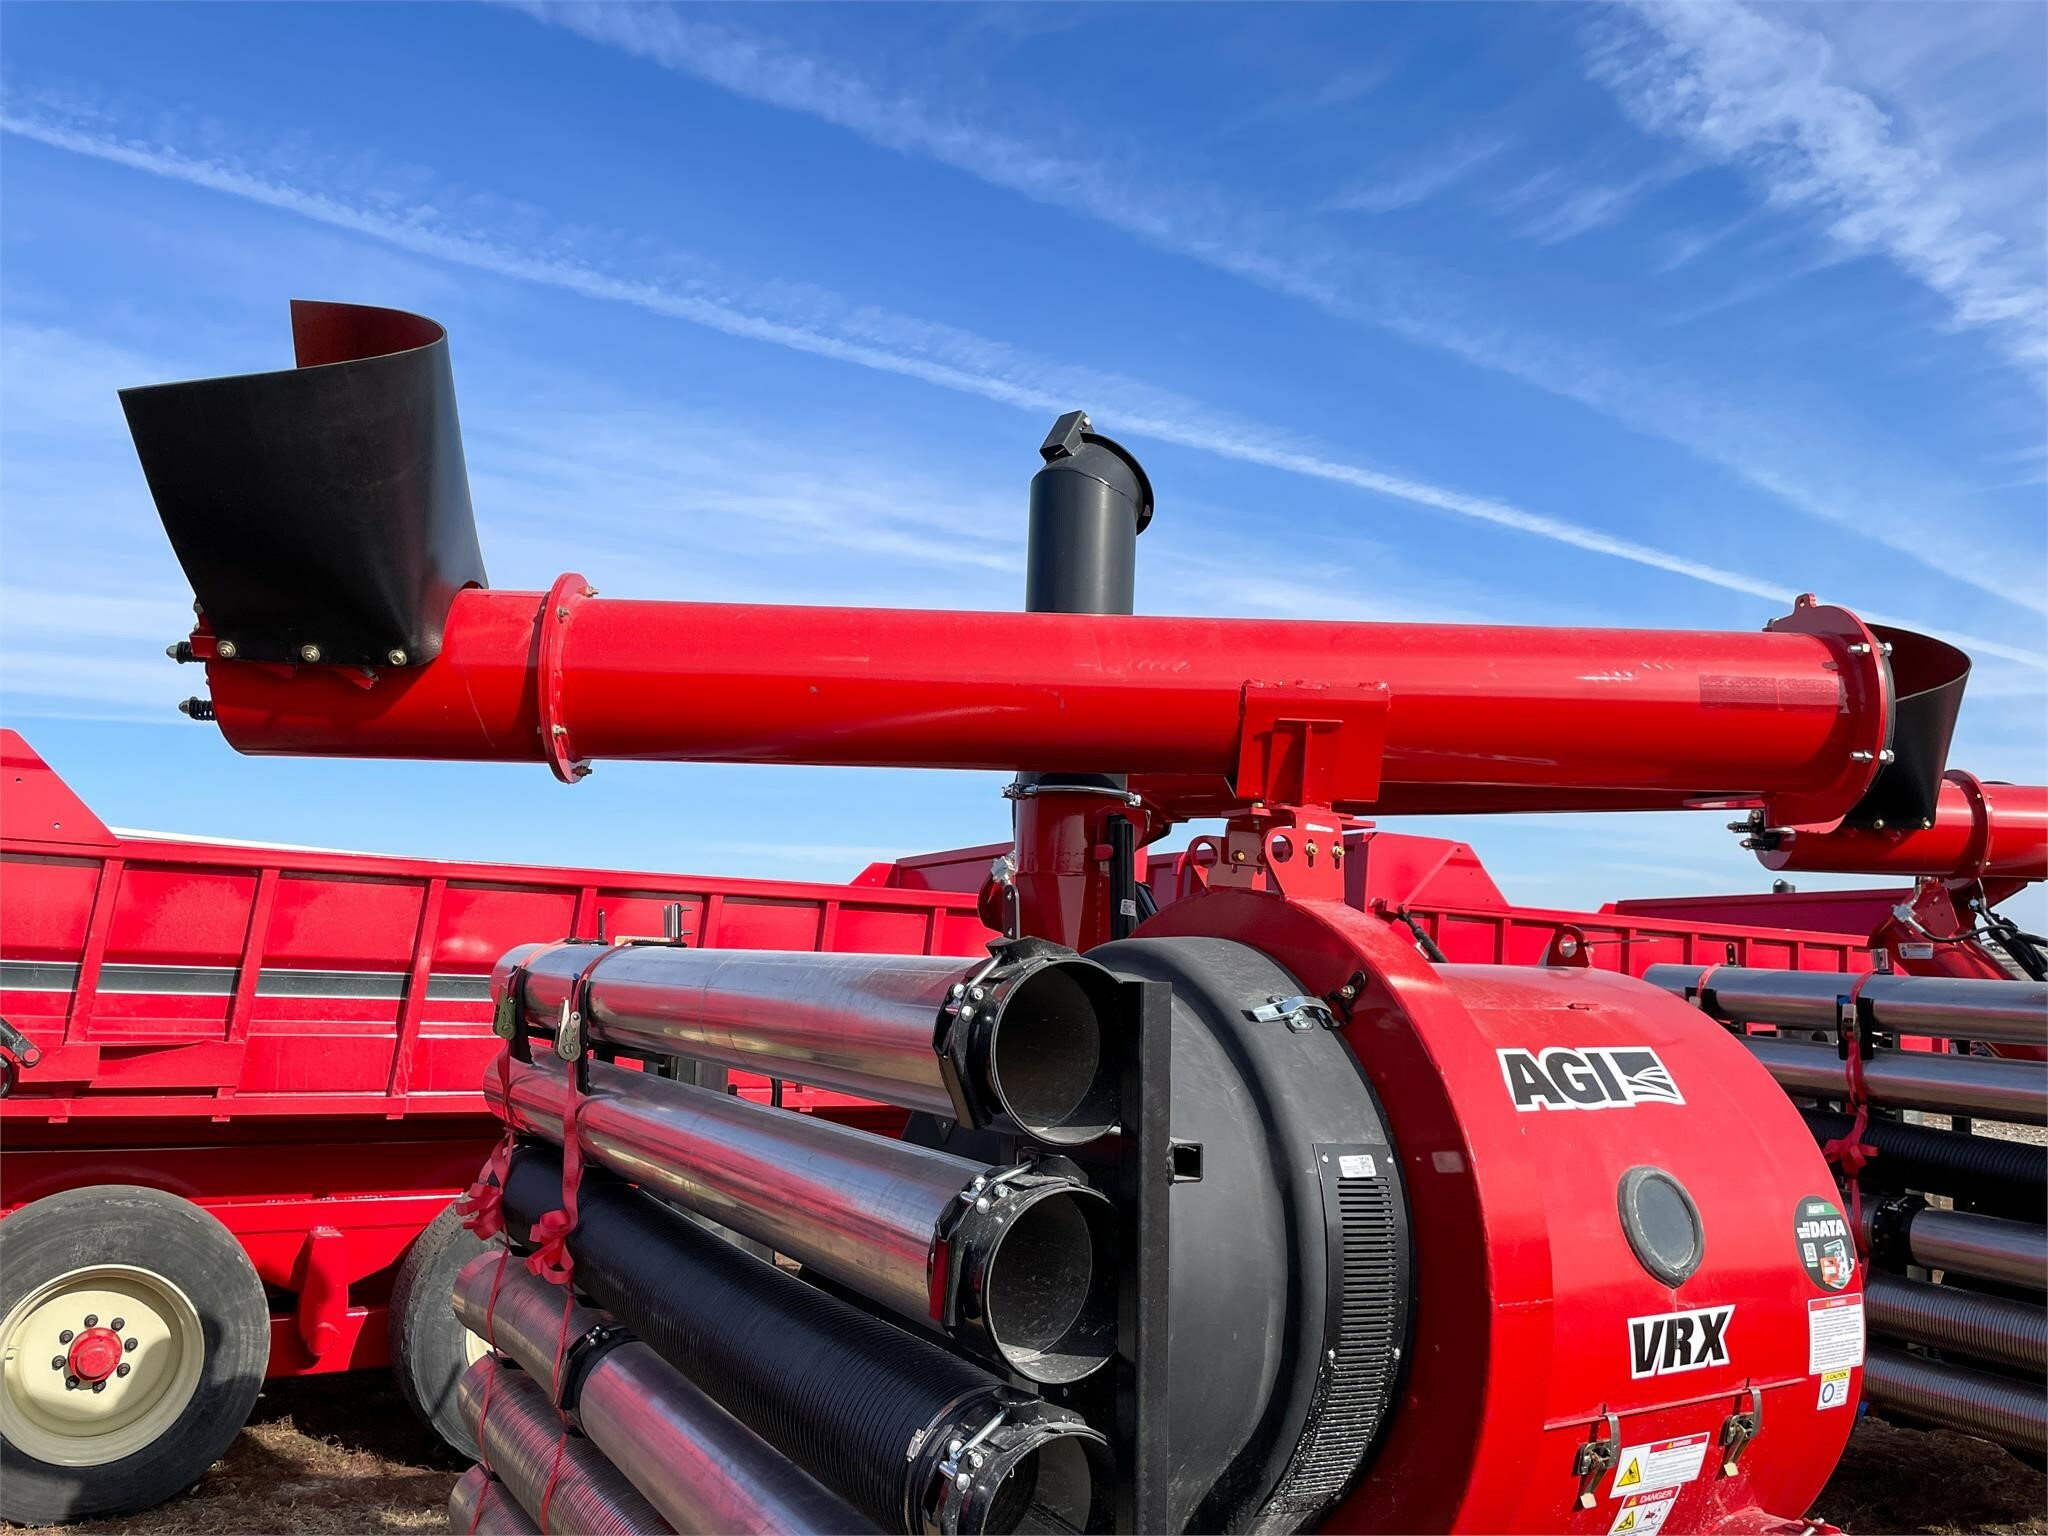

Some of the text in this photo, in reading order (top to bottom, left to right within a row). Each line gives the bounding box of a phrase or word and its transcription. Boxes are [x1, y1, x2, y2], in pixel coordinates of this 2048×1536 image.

[1504, 1052, 1628, 1105] AGI
[1810, 1220, 1847, 1238] DATA
[1632, 1311, 1729, 1373] VRX
[1640, 1490, 1673, 1503] DANGER
